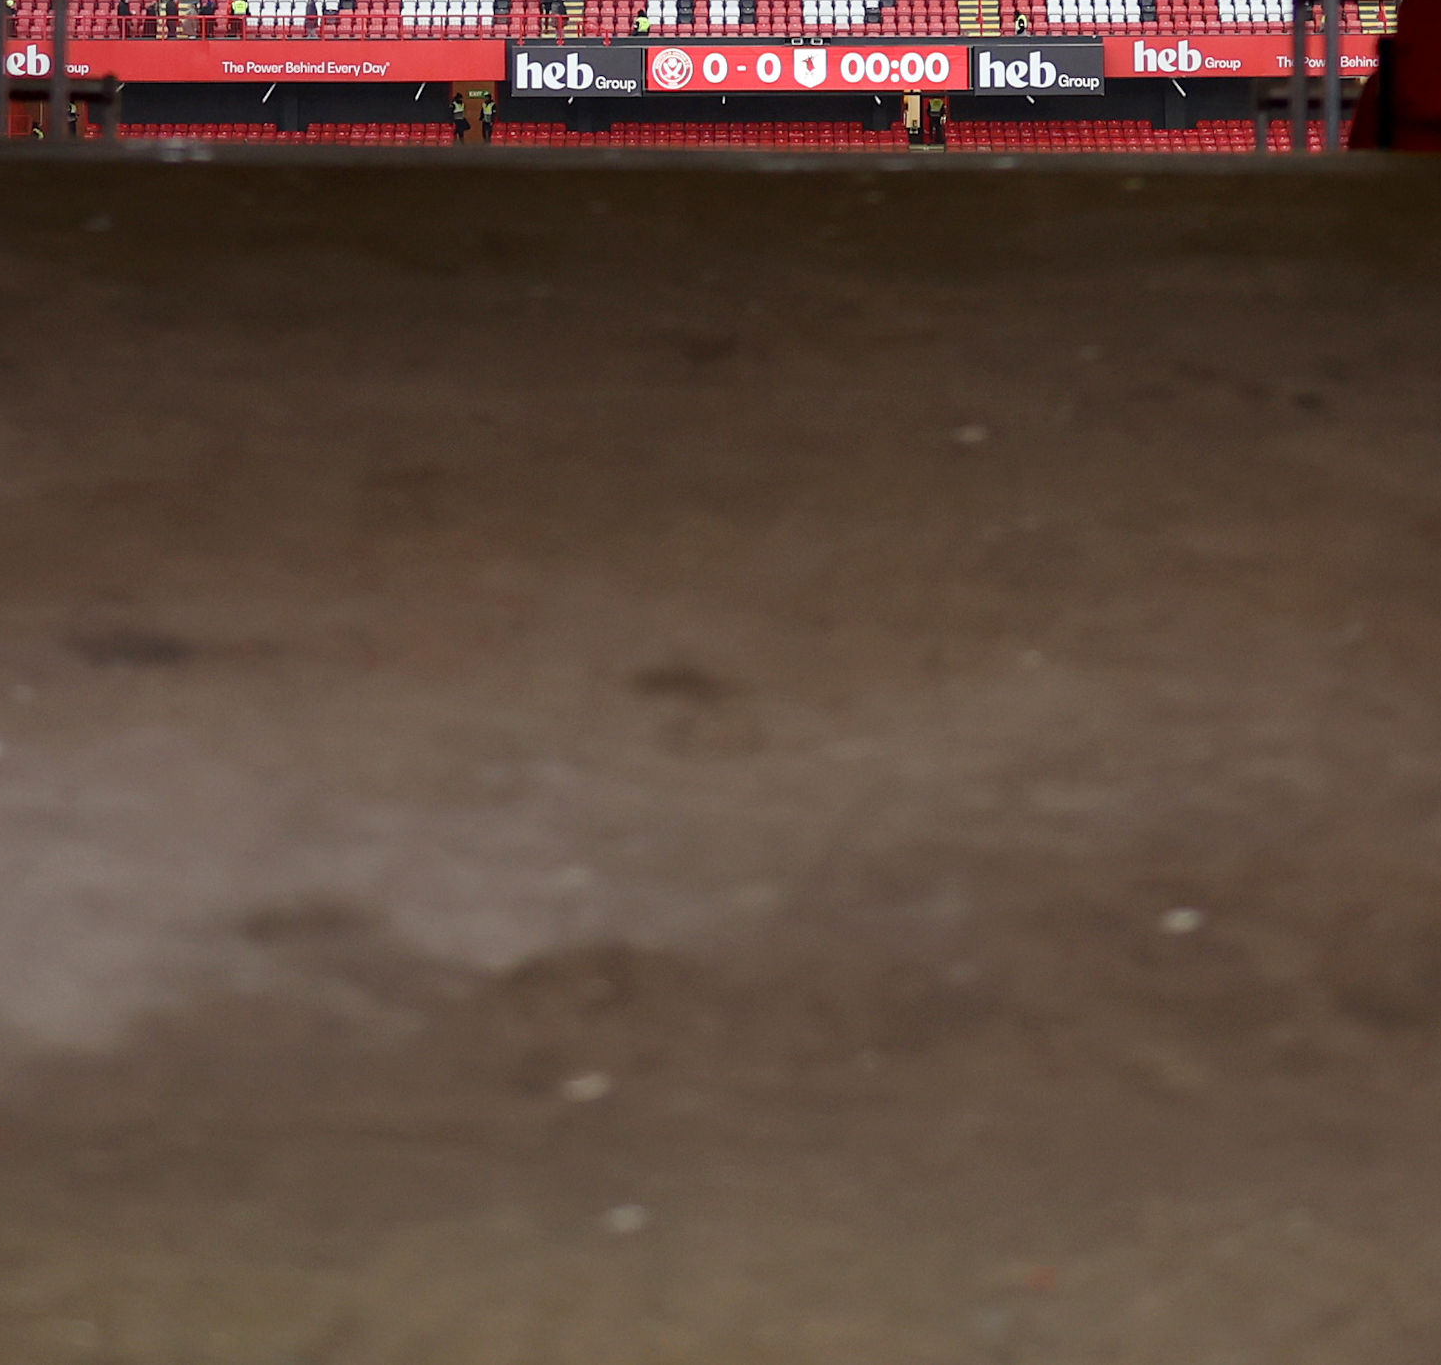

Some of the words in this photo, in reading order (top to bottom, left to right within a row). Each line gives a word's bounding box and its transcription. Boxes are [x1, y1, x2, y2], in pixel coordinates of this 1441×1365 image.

[222, 61, 244, 74] The
[246, 61, 283, 74] Power
[285, 61, 325, 74] Behind
[327, 61, 360, 77] Every
[703, 52, 728, 83] 0
[756, 52, 782, 83] 0
[840, 52, 950, 83] 00:00
[979, 51, 1056, 88] heb
[1058, 75, 1100, 91] Group
[1133, 40, 1202, 72] heb
[1205, 57, 1241, 70] Group
[516, 52, 594, 90] heb
[595, 75, 637, 92] Group
